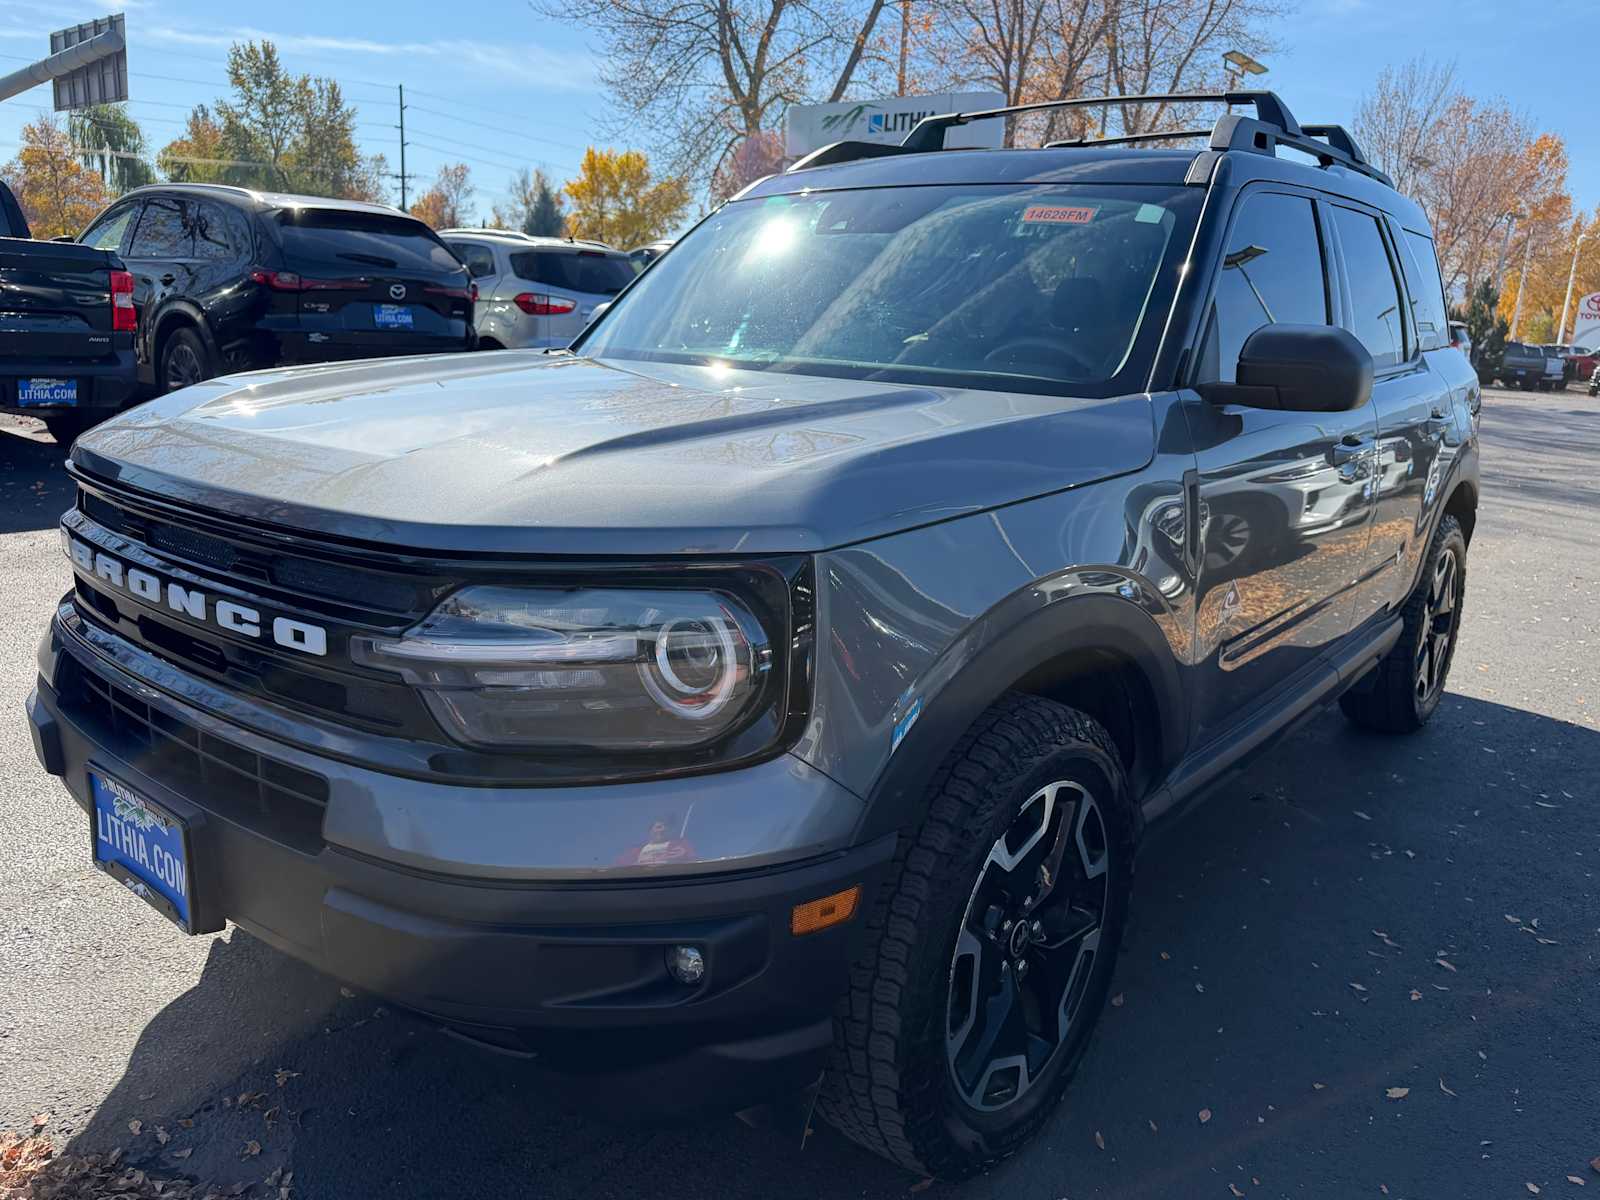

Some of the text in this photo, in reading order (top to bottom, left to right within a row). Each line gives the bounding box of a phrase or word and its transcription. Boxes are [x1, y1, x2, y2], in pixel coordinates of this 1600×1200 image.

[884, 110, 936, 132] LITH
[1029, 209, 1089, 222] 14628FM
[1580, 312, 1600, 320] TOY
[18, 389, 77, 400] LITHIA.COM
[71, 538, 327, 657] BRONCO
